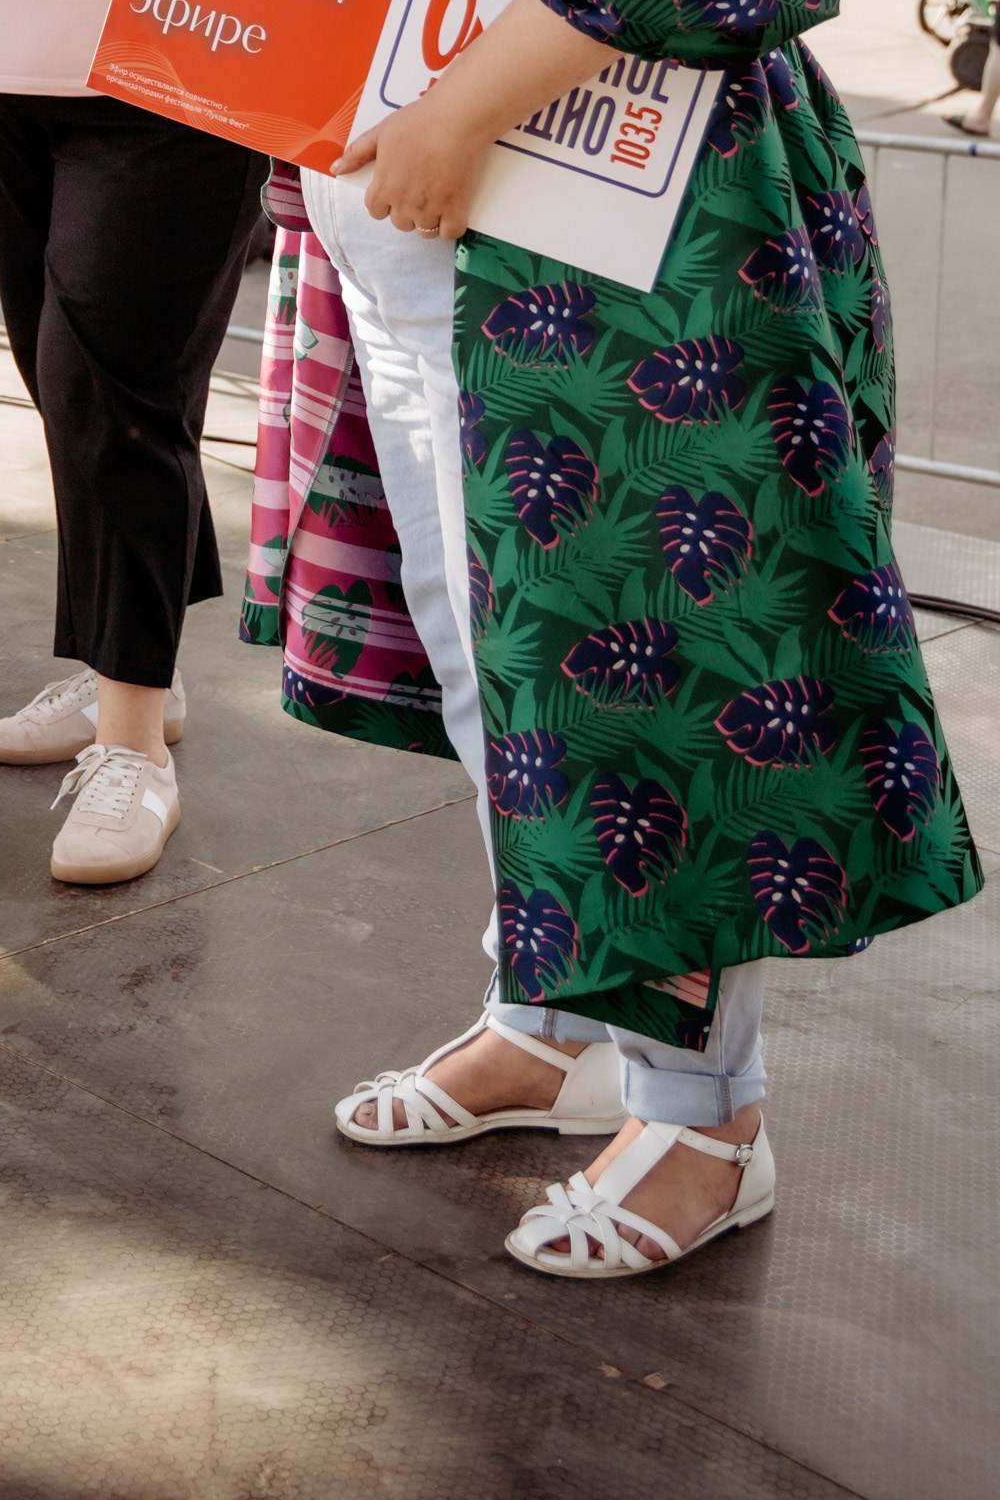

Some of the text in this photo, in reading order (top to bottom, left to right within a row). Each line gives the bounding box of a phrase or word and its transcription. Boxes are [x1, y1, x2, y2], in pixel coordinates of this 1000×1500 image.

[105, 74, 250, 130] организаторами фестиваля "Луков Фест"
[109, 62, 128, 76] Эфир
[128, 71, 185, 96] осуществляется
[185, 91, 223, 111] совместно
[514, 86, 616, 155] ДИО
[609, 101, 663, 171] 103.5
